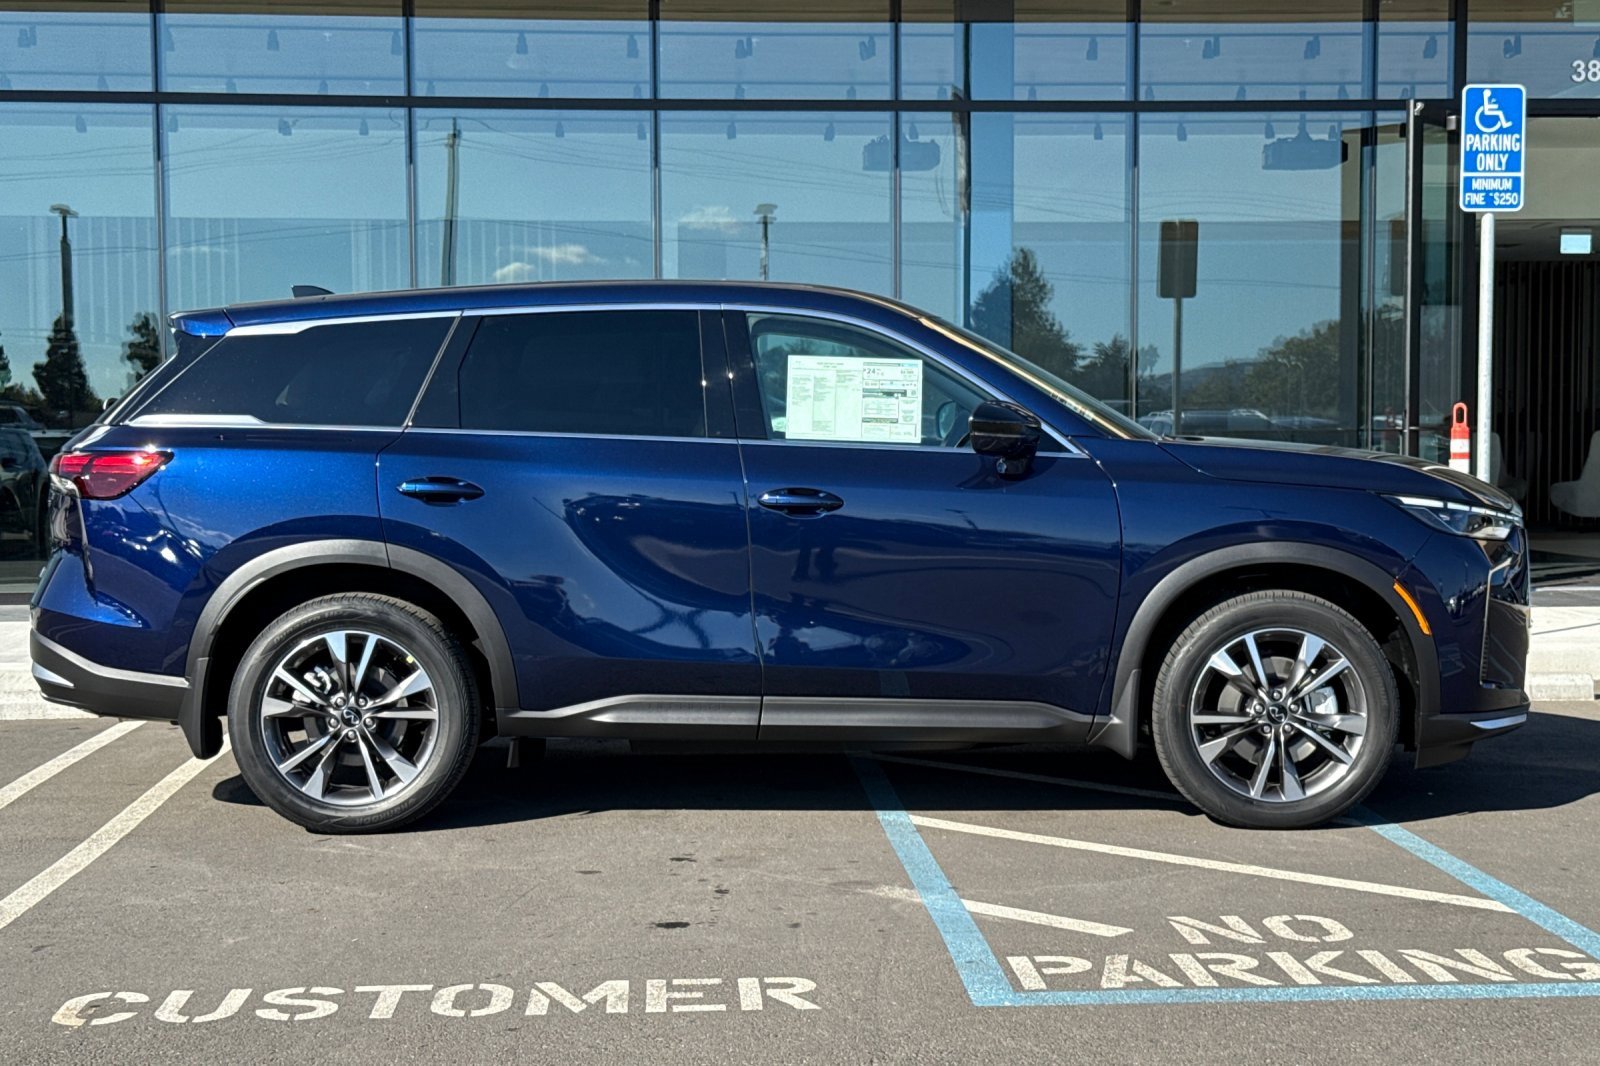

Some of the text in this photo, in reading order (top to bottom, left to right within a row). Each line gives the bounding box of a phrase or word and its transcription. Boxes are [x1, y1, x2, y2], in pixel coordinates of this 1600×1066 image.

[1465, 133, 1520, 151] PARKING
[1476, 152, 1509, 171] ONLY
[1471, 178, 1513, 191] MINIMUM
[1465, 192, 1518, 206] FINE $250
[1166, 914, 1355, 944] NO
[1006, 947, 1600, 990] PARKING
[50, 975, 821, 1027] CUSTOMER
